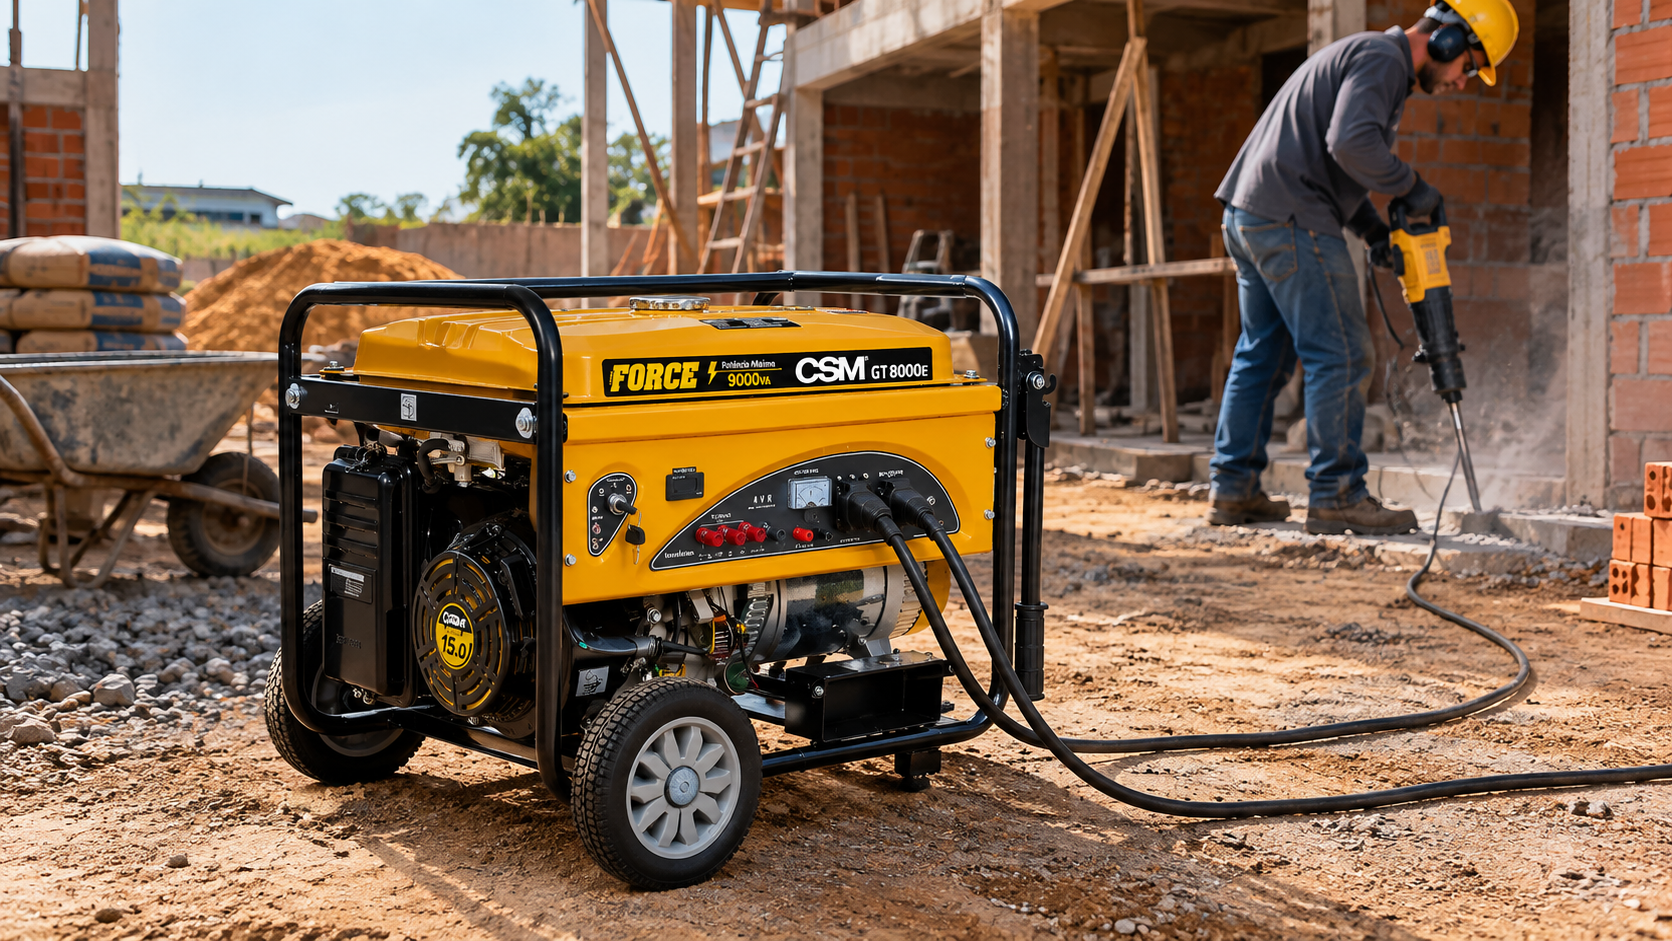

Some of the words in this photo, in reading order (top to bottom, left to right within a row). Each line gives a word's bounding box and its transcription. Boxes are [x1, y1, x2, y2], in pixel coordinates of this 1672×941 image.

[610, 361, 700, 392] FORCE
[795, 356, 865, 384] CSM
[871, 365, 888, 379] GT
[889, 363, 929, 378] 8000E
